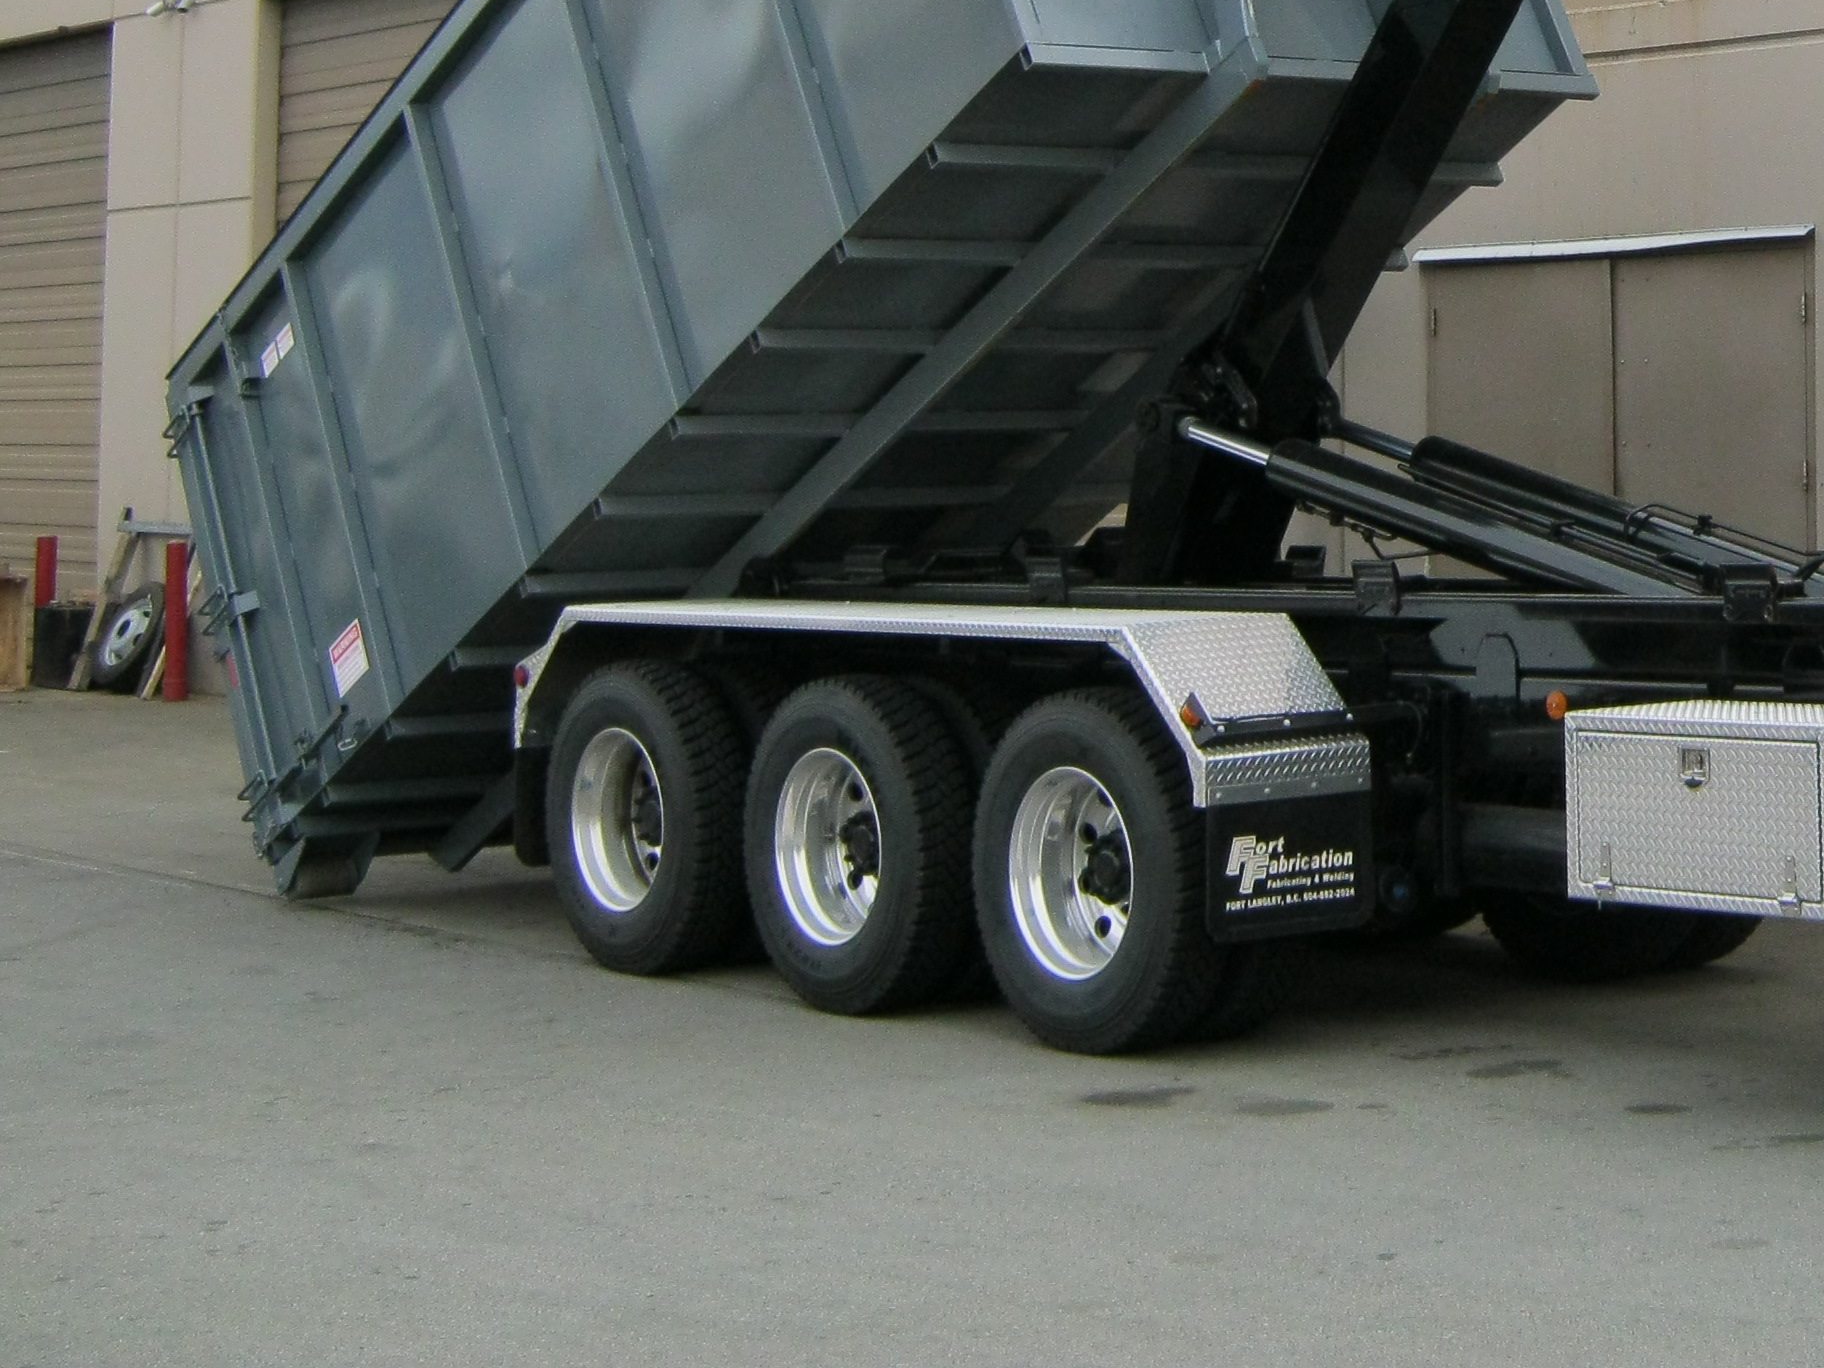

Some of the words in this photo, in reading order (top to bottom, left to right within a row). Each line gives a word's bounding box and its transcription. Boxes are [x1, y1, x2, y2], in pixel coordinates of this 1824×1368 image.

[1226, 836, 1284, 875] Fort
[1239, 849, 1353, 894] Fabrication
[1225, 899, 1247, 912] FORT
